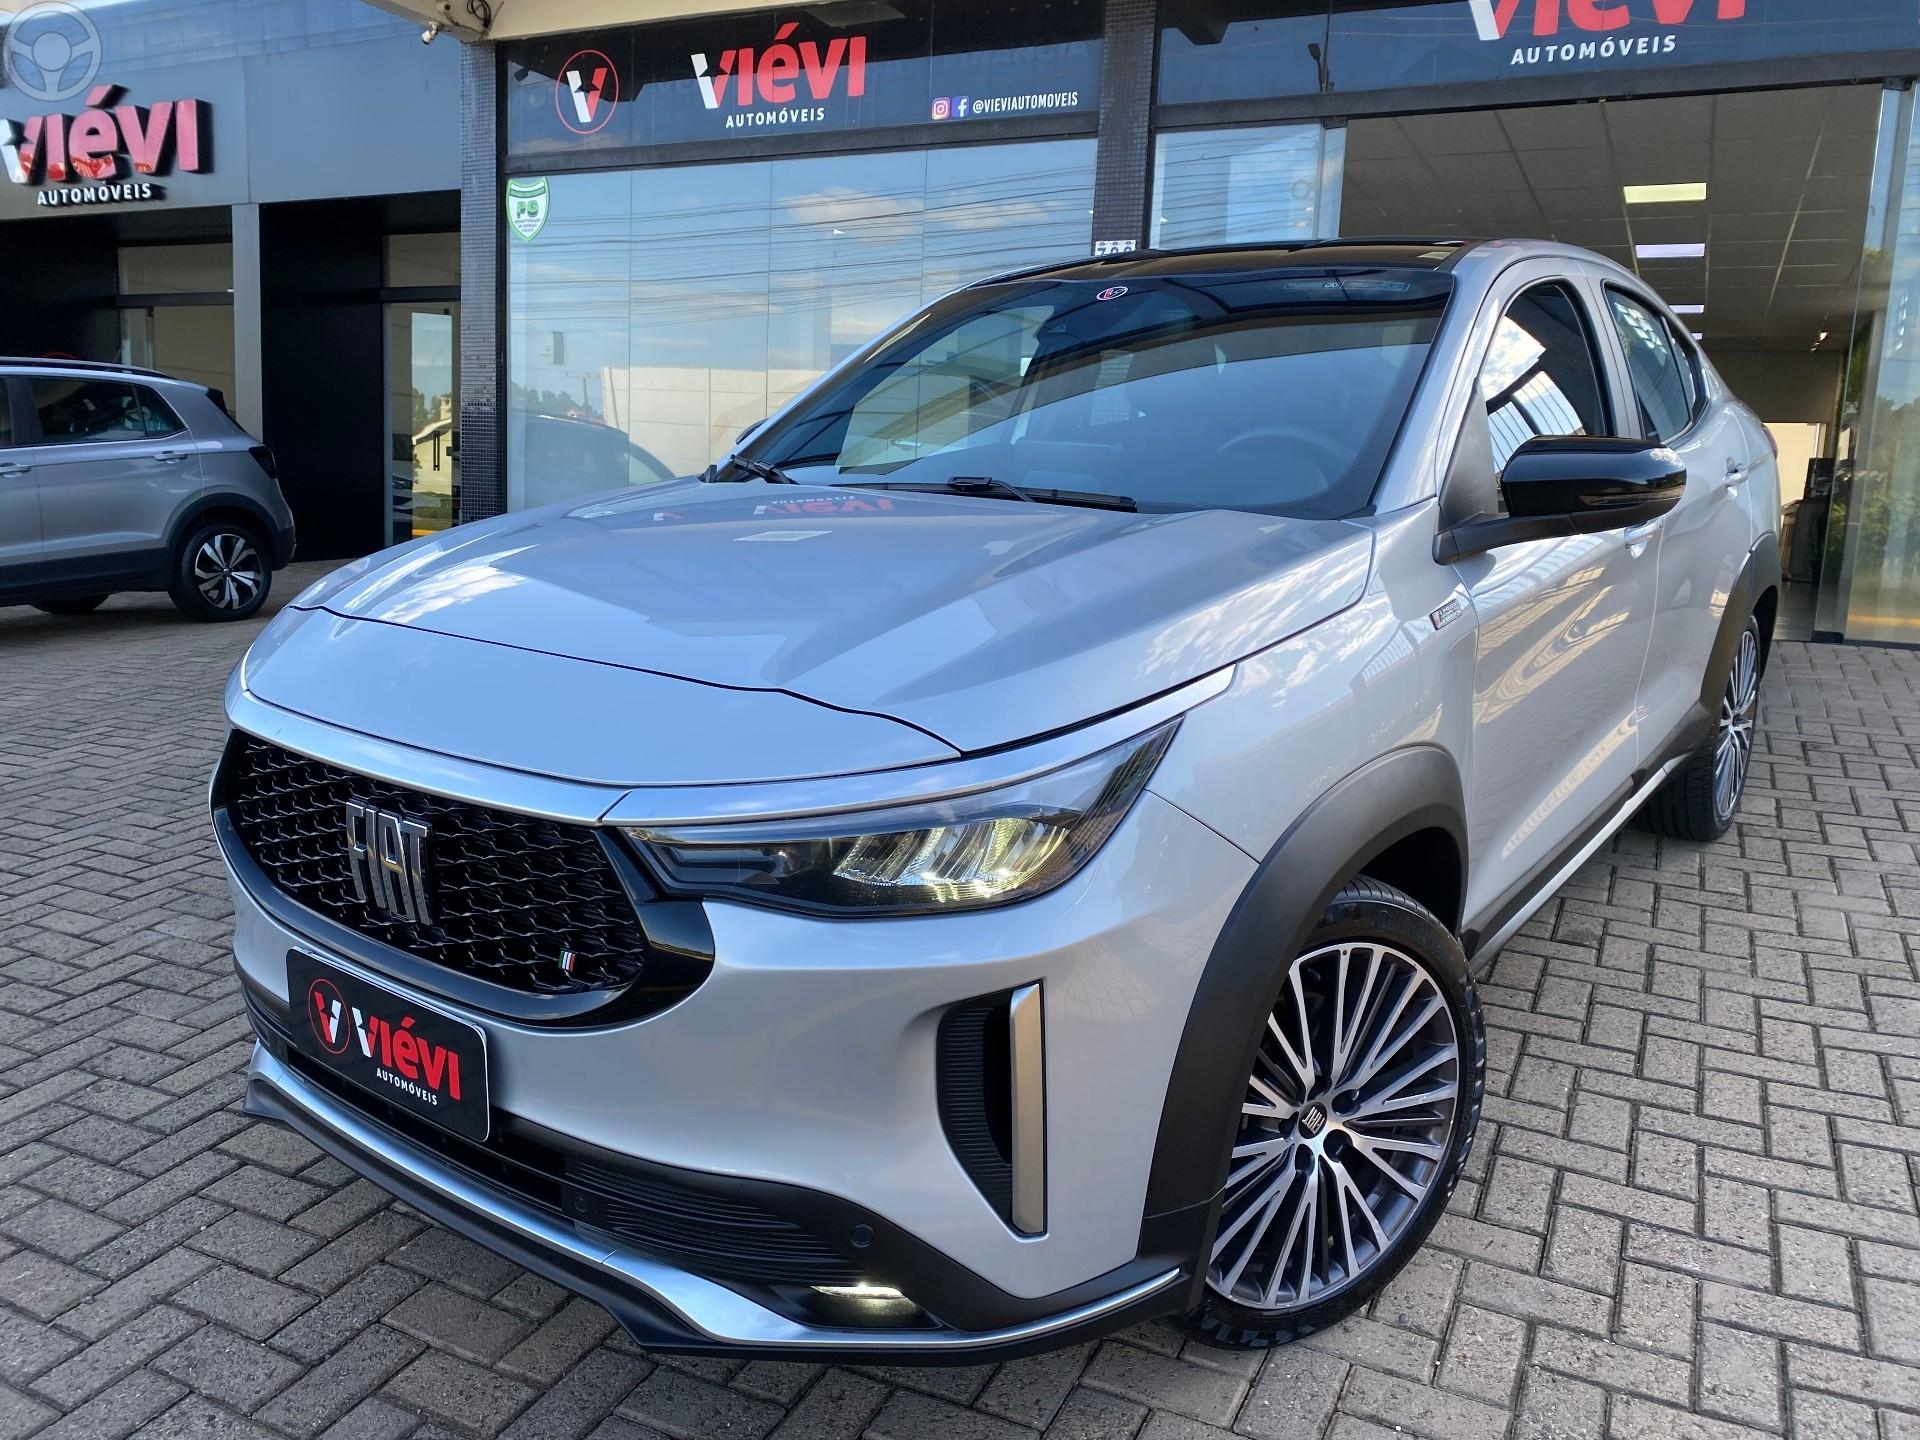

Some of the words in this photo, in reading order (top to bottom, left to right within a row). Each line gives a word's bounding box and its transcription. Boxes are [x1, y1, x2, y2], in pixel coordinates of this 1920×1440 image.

[1510, 35, 1678, 65] AUTOMÓVEIS
[972, 91, 1079, 114] @VIEVIAUTOMOVEIS
[725, 105, 826, 129] AUTOMÓVEIS
[37, 181, 153, 206] AUTOMÓVEIS
[345, 799, 432, 926] FIAT
[376, 1067, 438, 1106] AUTOMÓVEIS
